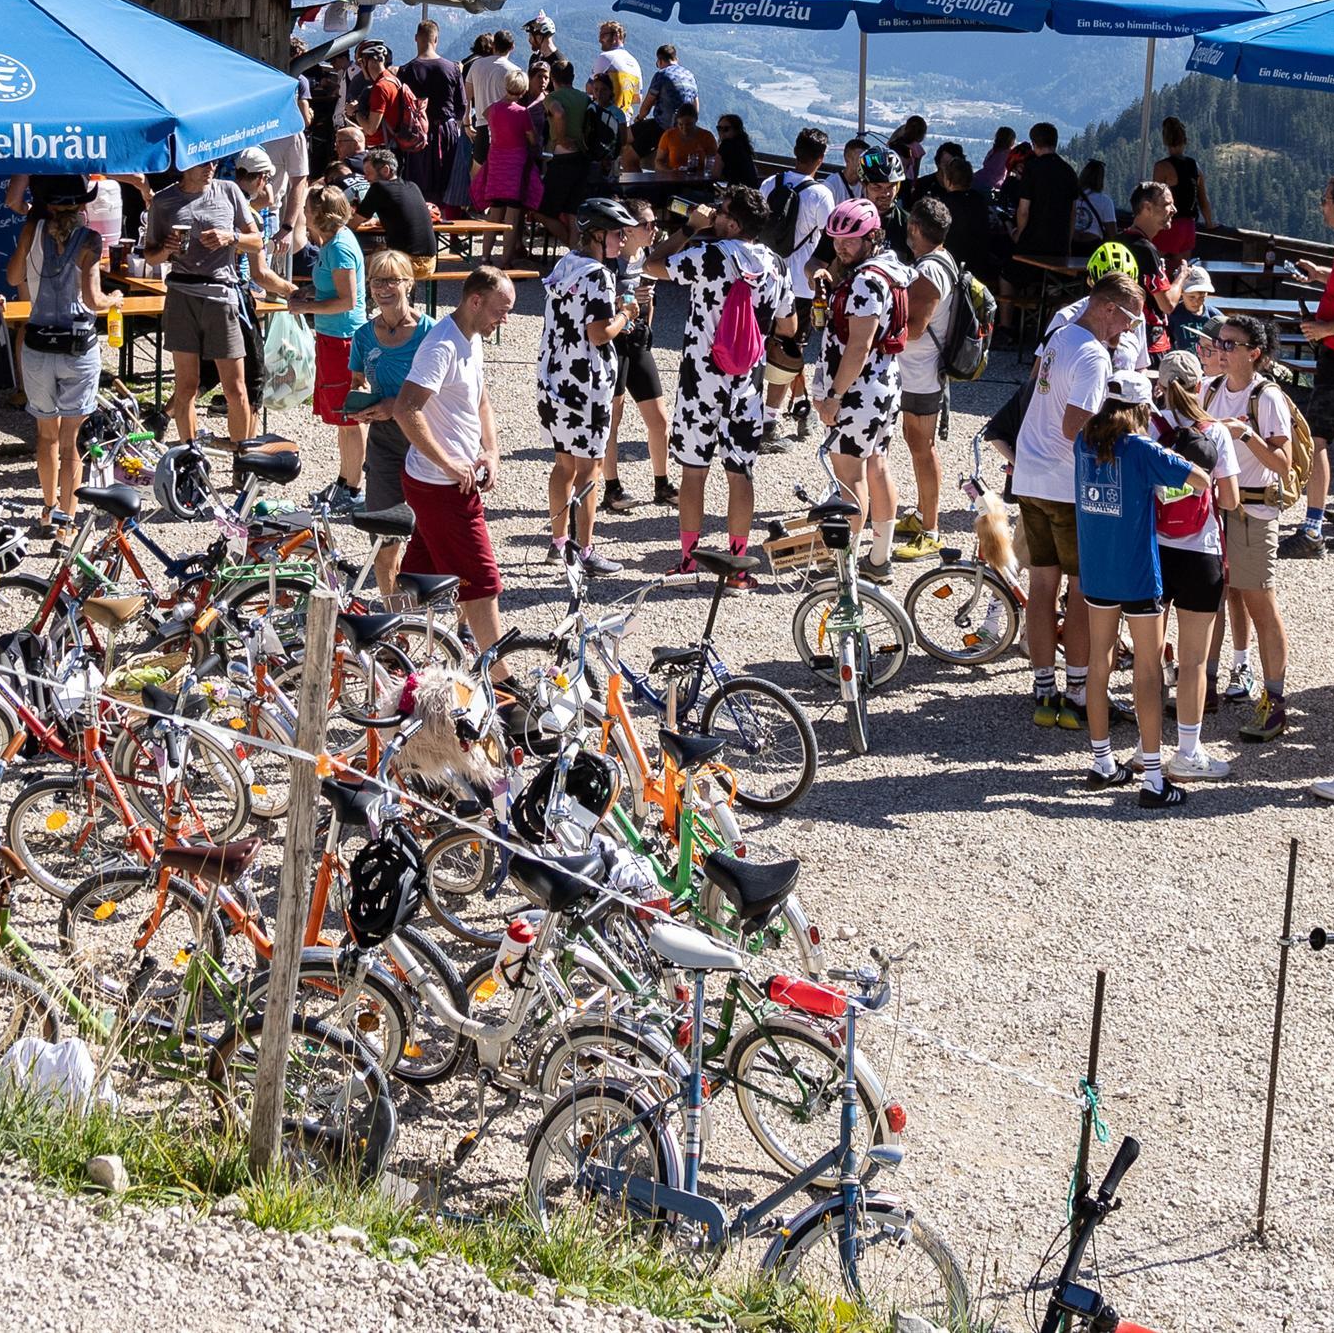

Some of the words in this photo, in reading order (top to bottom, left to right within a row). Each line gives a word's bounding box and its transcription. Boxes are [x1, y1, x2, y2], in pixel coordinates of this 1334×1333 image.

[878, 18, 891, 27] Ein
[893, 18, 911, 27] Bier,
[922, 17, 962, 26] himmlisch
[1077, 19, 1091, 28] Ein
[1093, 19, 1113, 30] Bier,
[1127, 20, 1172, 32] himmlisch
[1174, 23, 1190, 33] wie
[1259, 67, 1271, 78] Ein
[1272, 69, 1290, 80] Bier,
